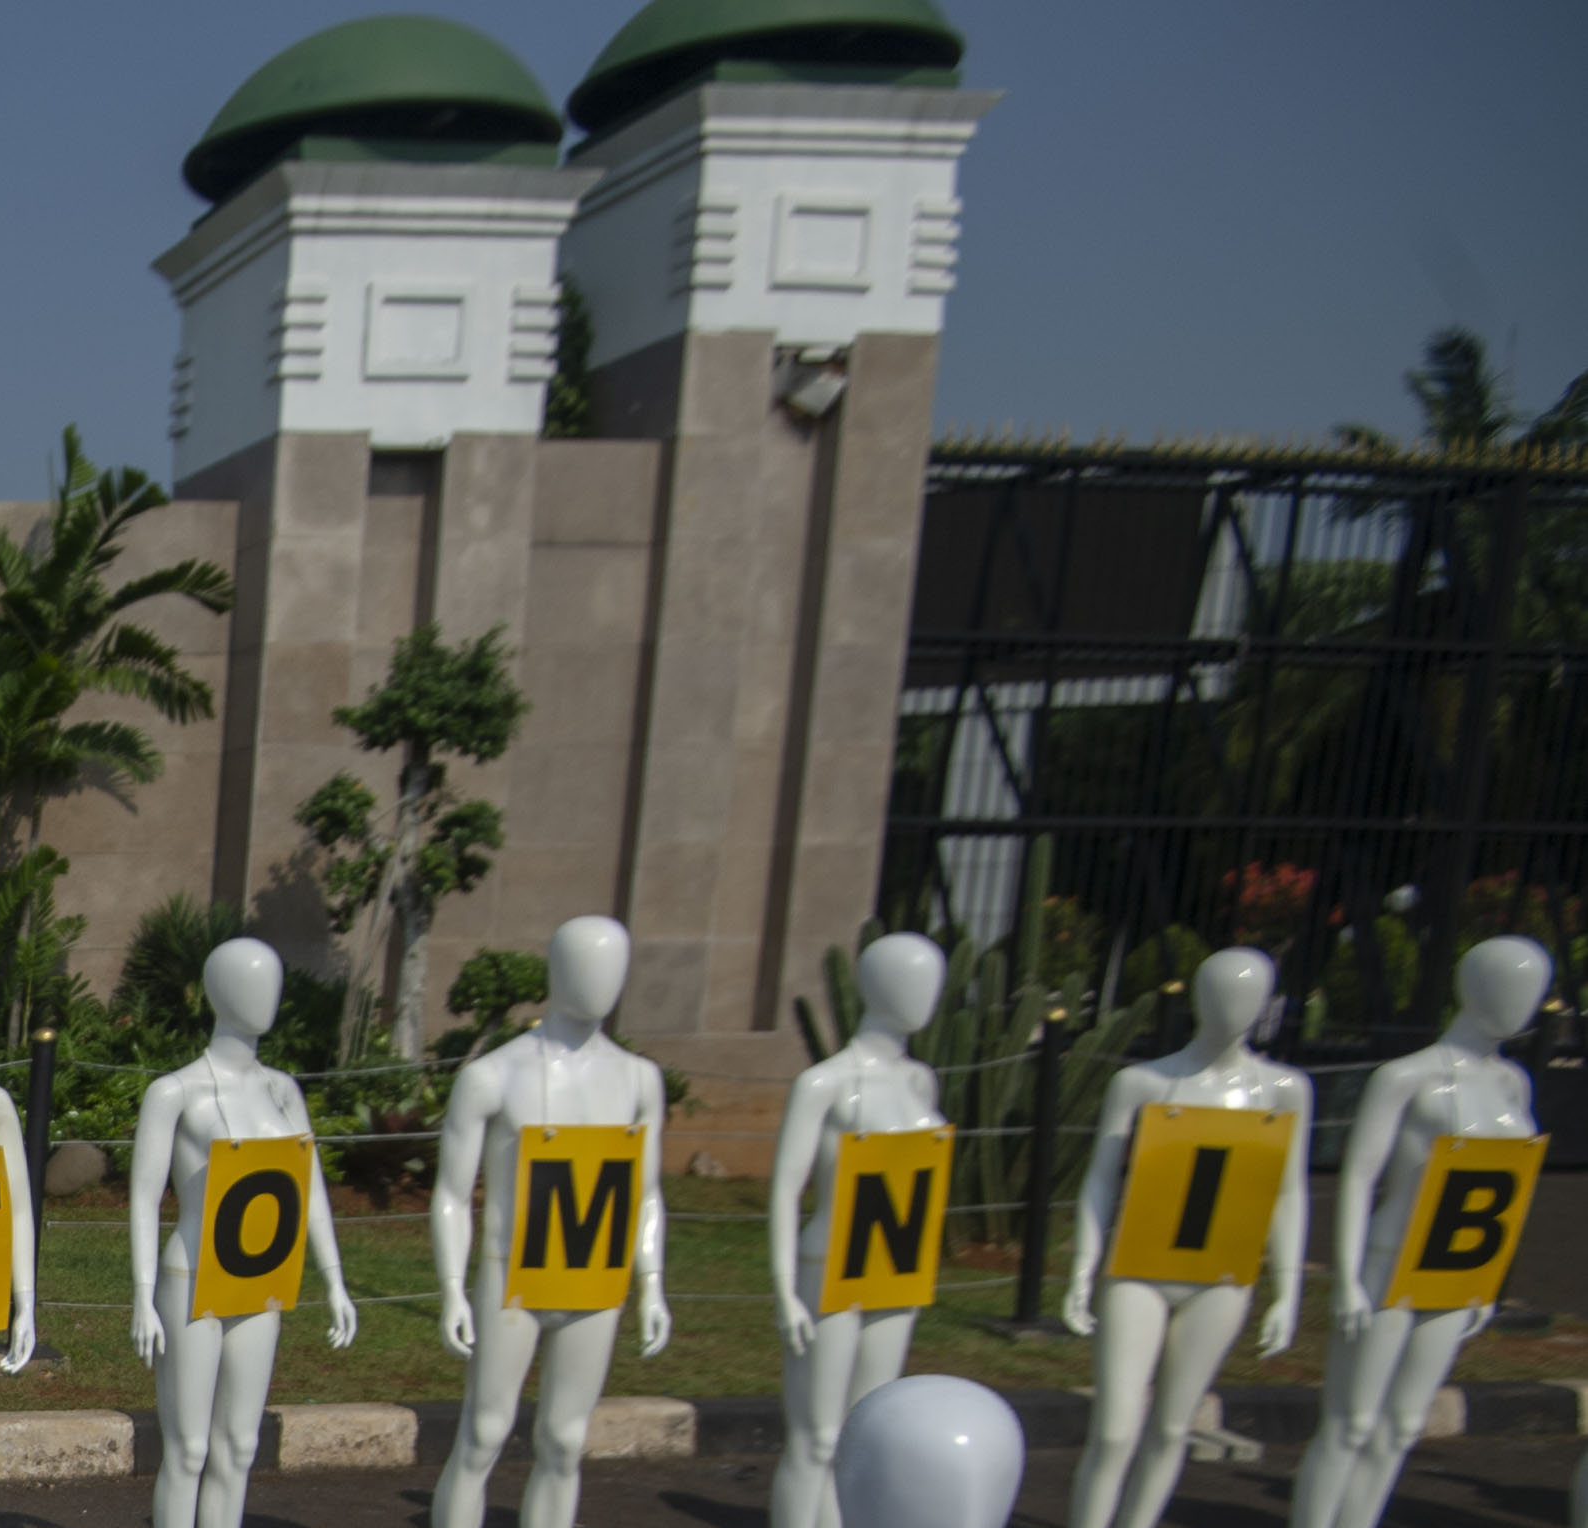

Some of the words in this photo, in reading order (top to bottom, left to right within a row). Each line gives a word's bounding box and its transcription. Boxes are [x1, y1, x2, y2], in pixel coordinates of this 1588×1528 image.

[214, 1170, 300, 1277] O
[520, 1159, 634, 1268] M
[843, 1169, 932, 1279] N
[1173, 1147, 1229, 1251] I
[1413, 1168, 1519, 1270] B
